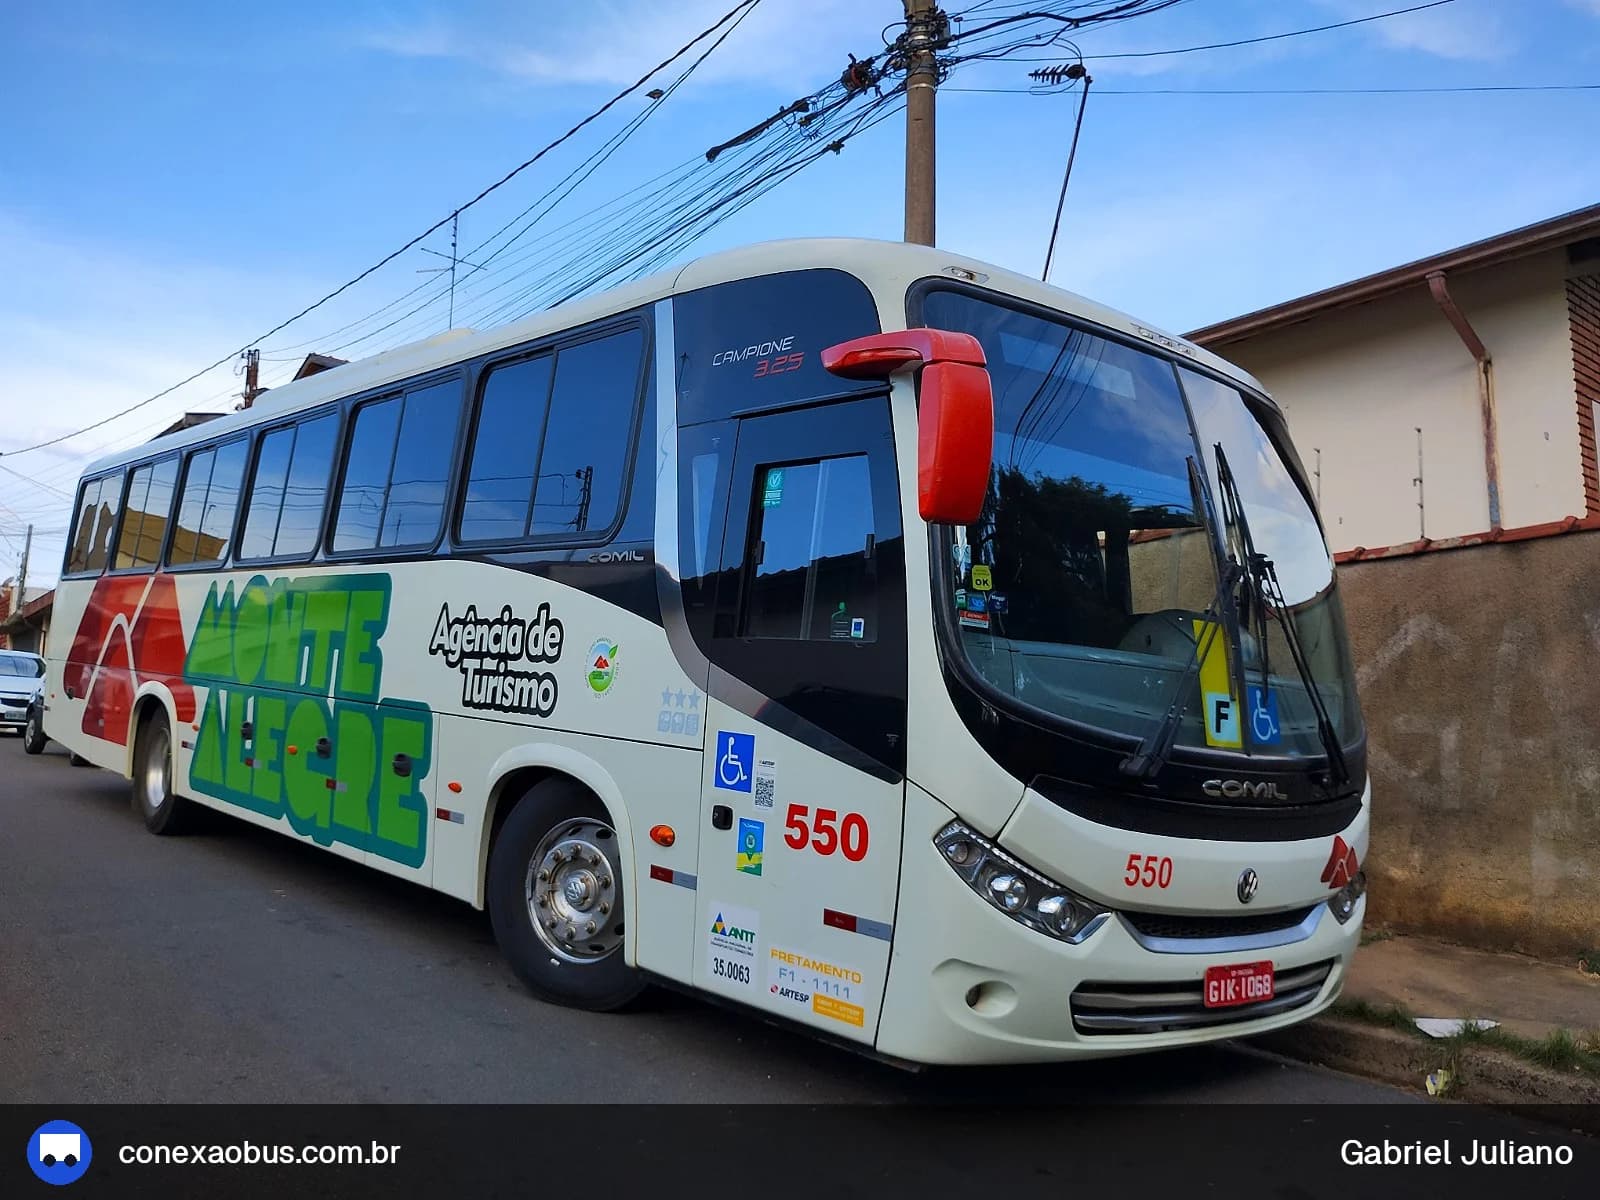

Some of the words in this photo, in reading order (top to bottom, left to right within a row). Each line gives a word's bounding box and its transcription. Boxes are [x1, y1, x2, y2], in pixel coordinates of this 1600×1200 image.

[712, 336, 795, 366] CAMPIONE
[753, 352, 805, 378] 3.25
[588, 550, 644, 563] COMIL
[975, 578, 989, 587] OK
[185, 577, 391, 697] MONTE
[430, 602, 525, 667] Agência
[526, 602, 563, 663] de
[461, 657, 558, 717] Turismo
[1215, 699, 1231, 734] F
[190, 688, 431, 860] ALEGRE
[1202, 780, 1288, 799] COMIL
[783, 803, 870, 862] 550
[1124, 853, 1173, 889] 550
[728, 927, 755, 943] ANTT
[713, 957, 750, 984] 35.0063
[770, 948, 862, 984] FRETAMENTO
[779, 987, 810, 1003] ARTESP
